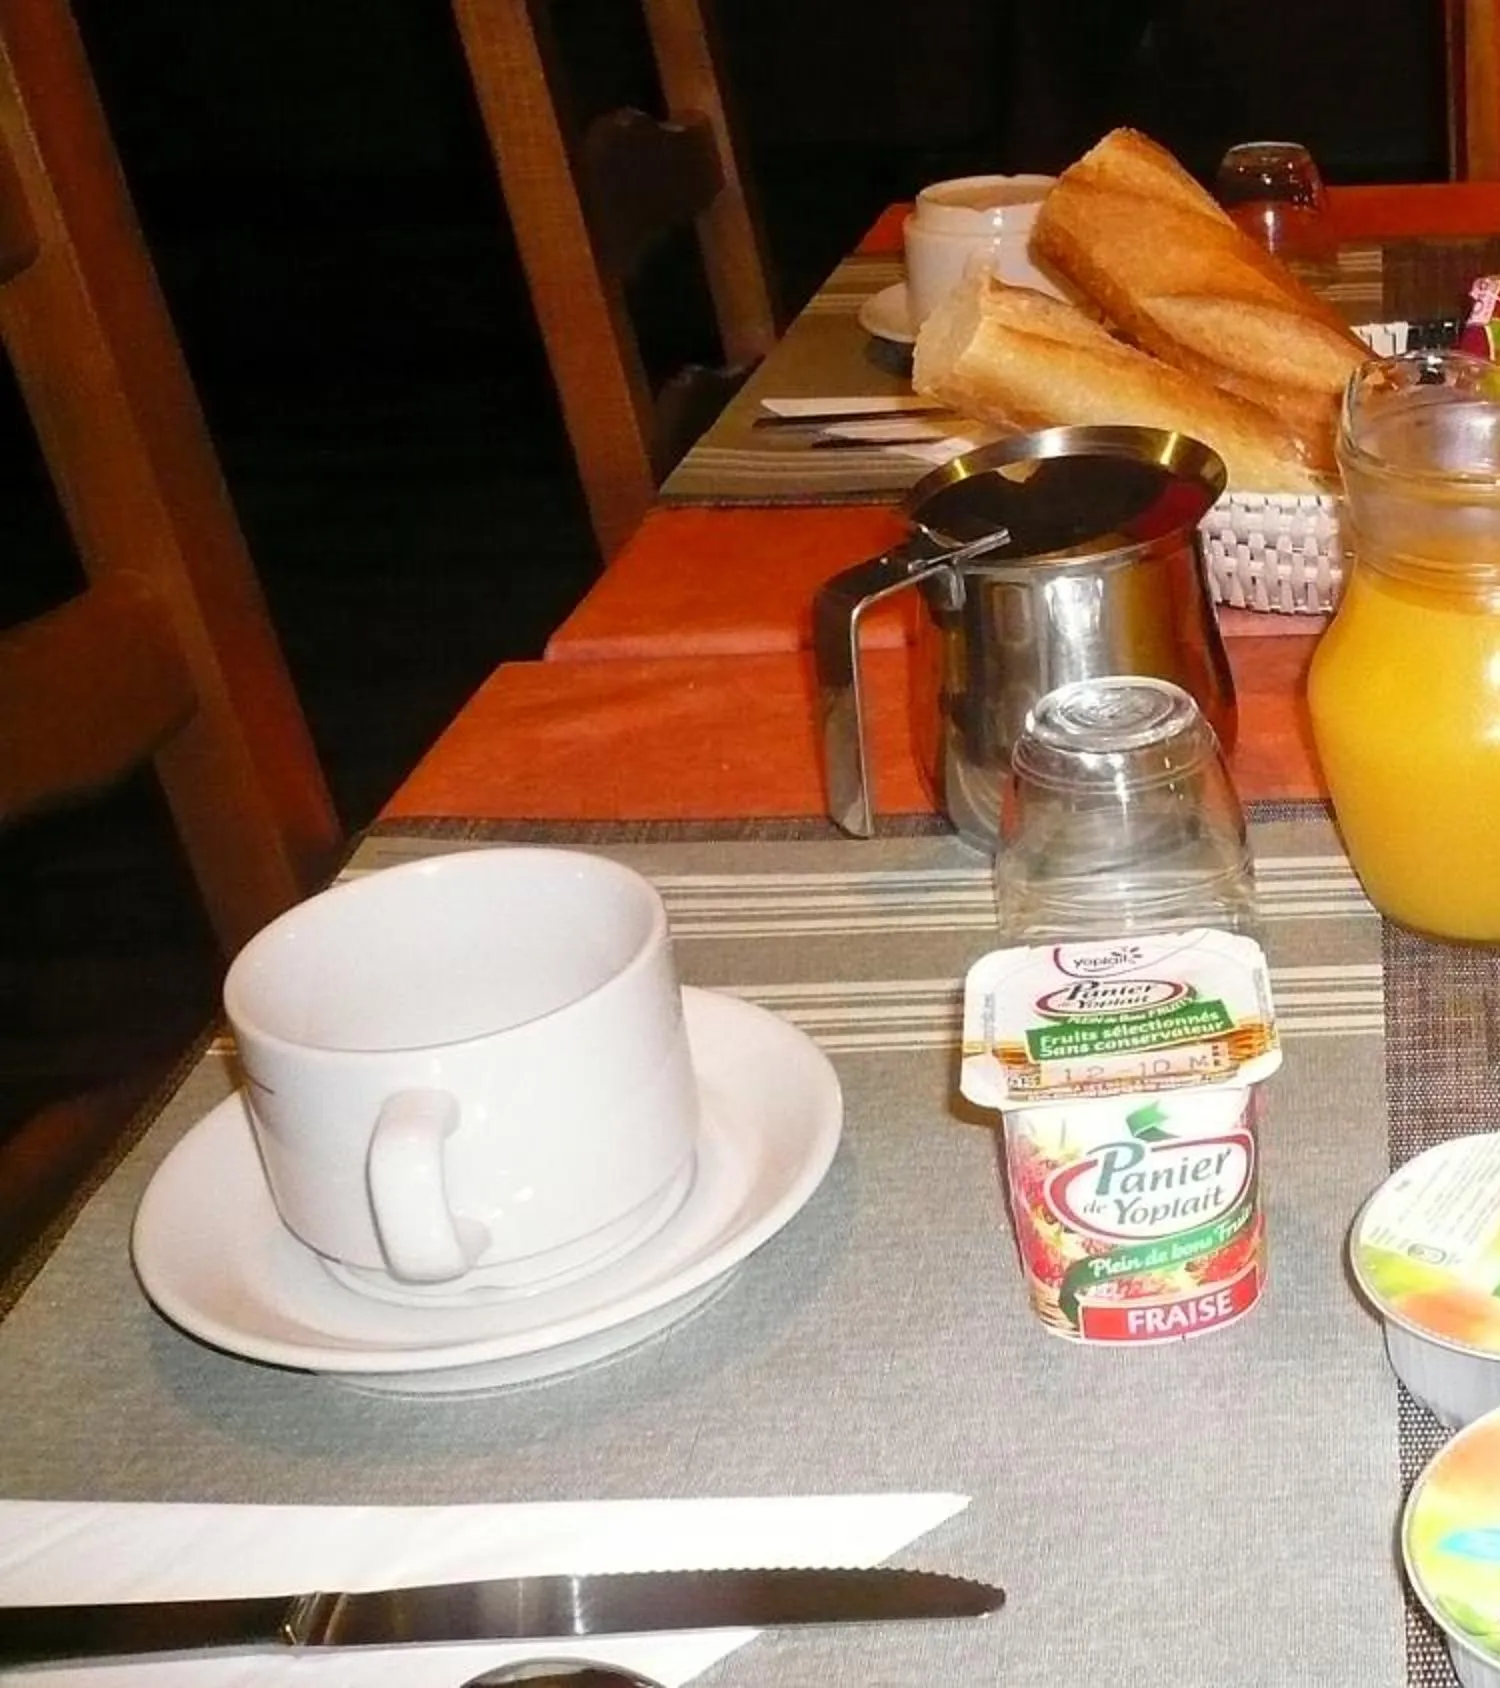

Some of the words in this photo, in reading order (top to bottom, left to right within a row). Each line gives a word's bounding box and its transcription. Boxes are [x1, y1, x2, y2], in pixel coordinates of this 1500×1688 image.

[1066, 980, 1154, 1000] Panier
[1039, 1044, 1089, 1058] Sans
[1095, 1021, 1224, 1051] conservateur
[1040, 1030, 1098, 1048] Fruits
[1103, 1009, 1220, 1038] sélectionnés
[1085, 1141, 1232, 1196] Panier
[1083, 1200, 1105, 1215] de
[1110, 1185, 1225, 1225] Yoplait
[1087, 1254, 1141, 1278] Plein
[1145, 1248, 1169, 1266] de
[1127, 1290, 1233, 1335] FRAISE
